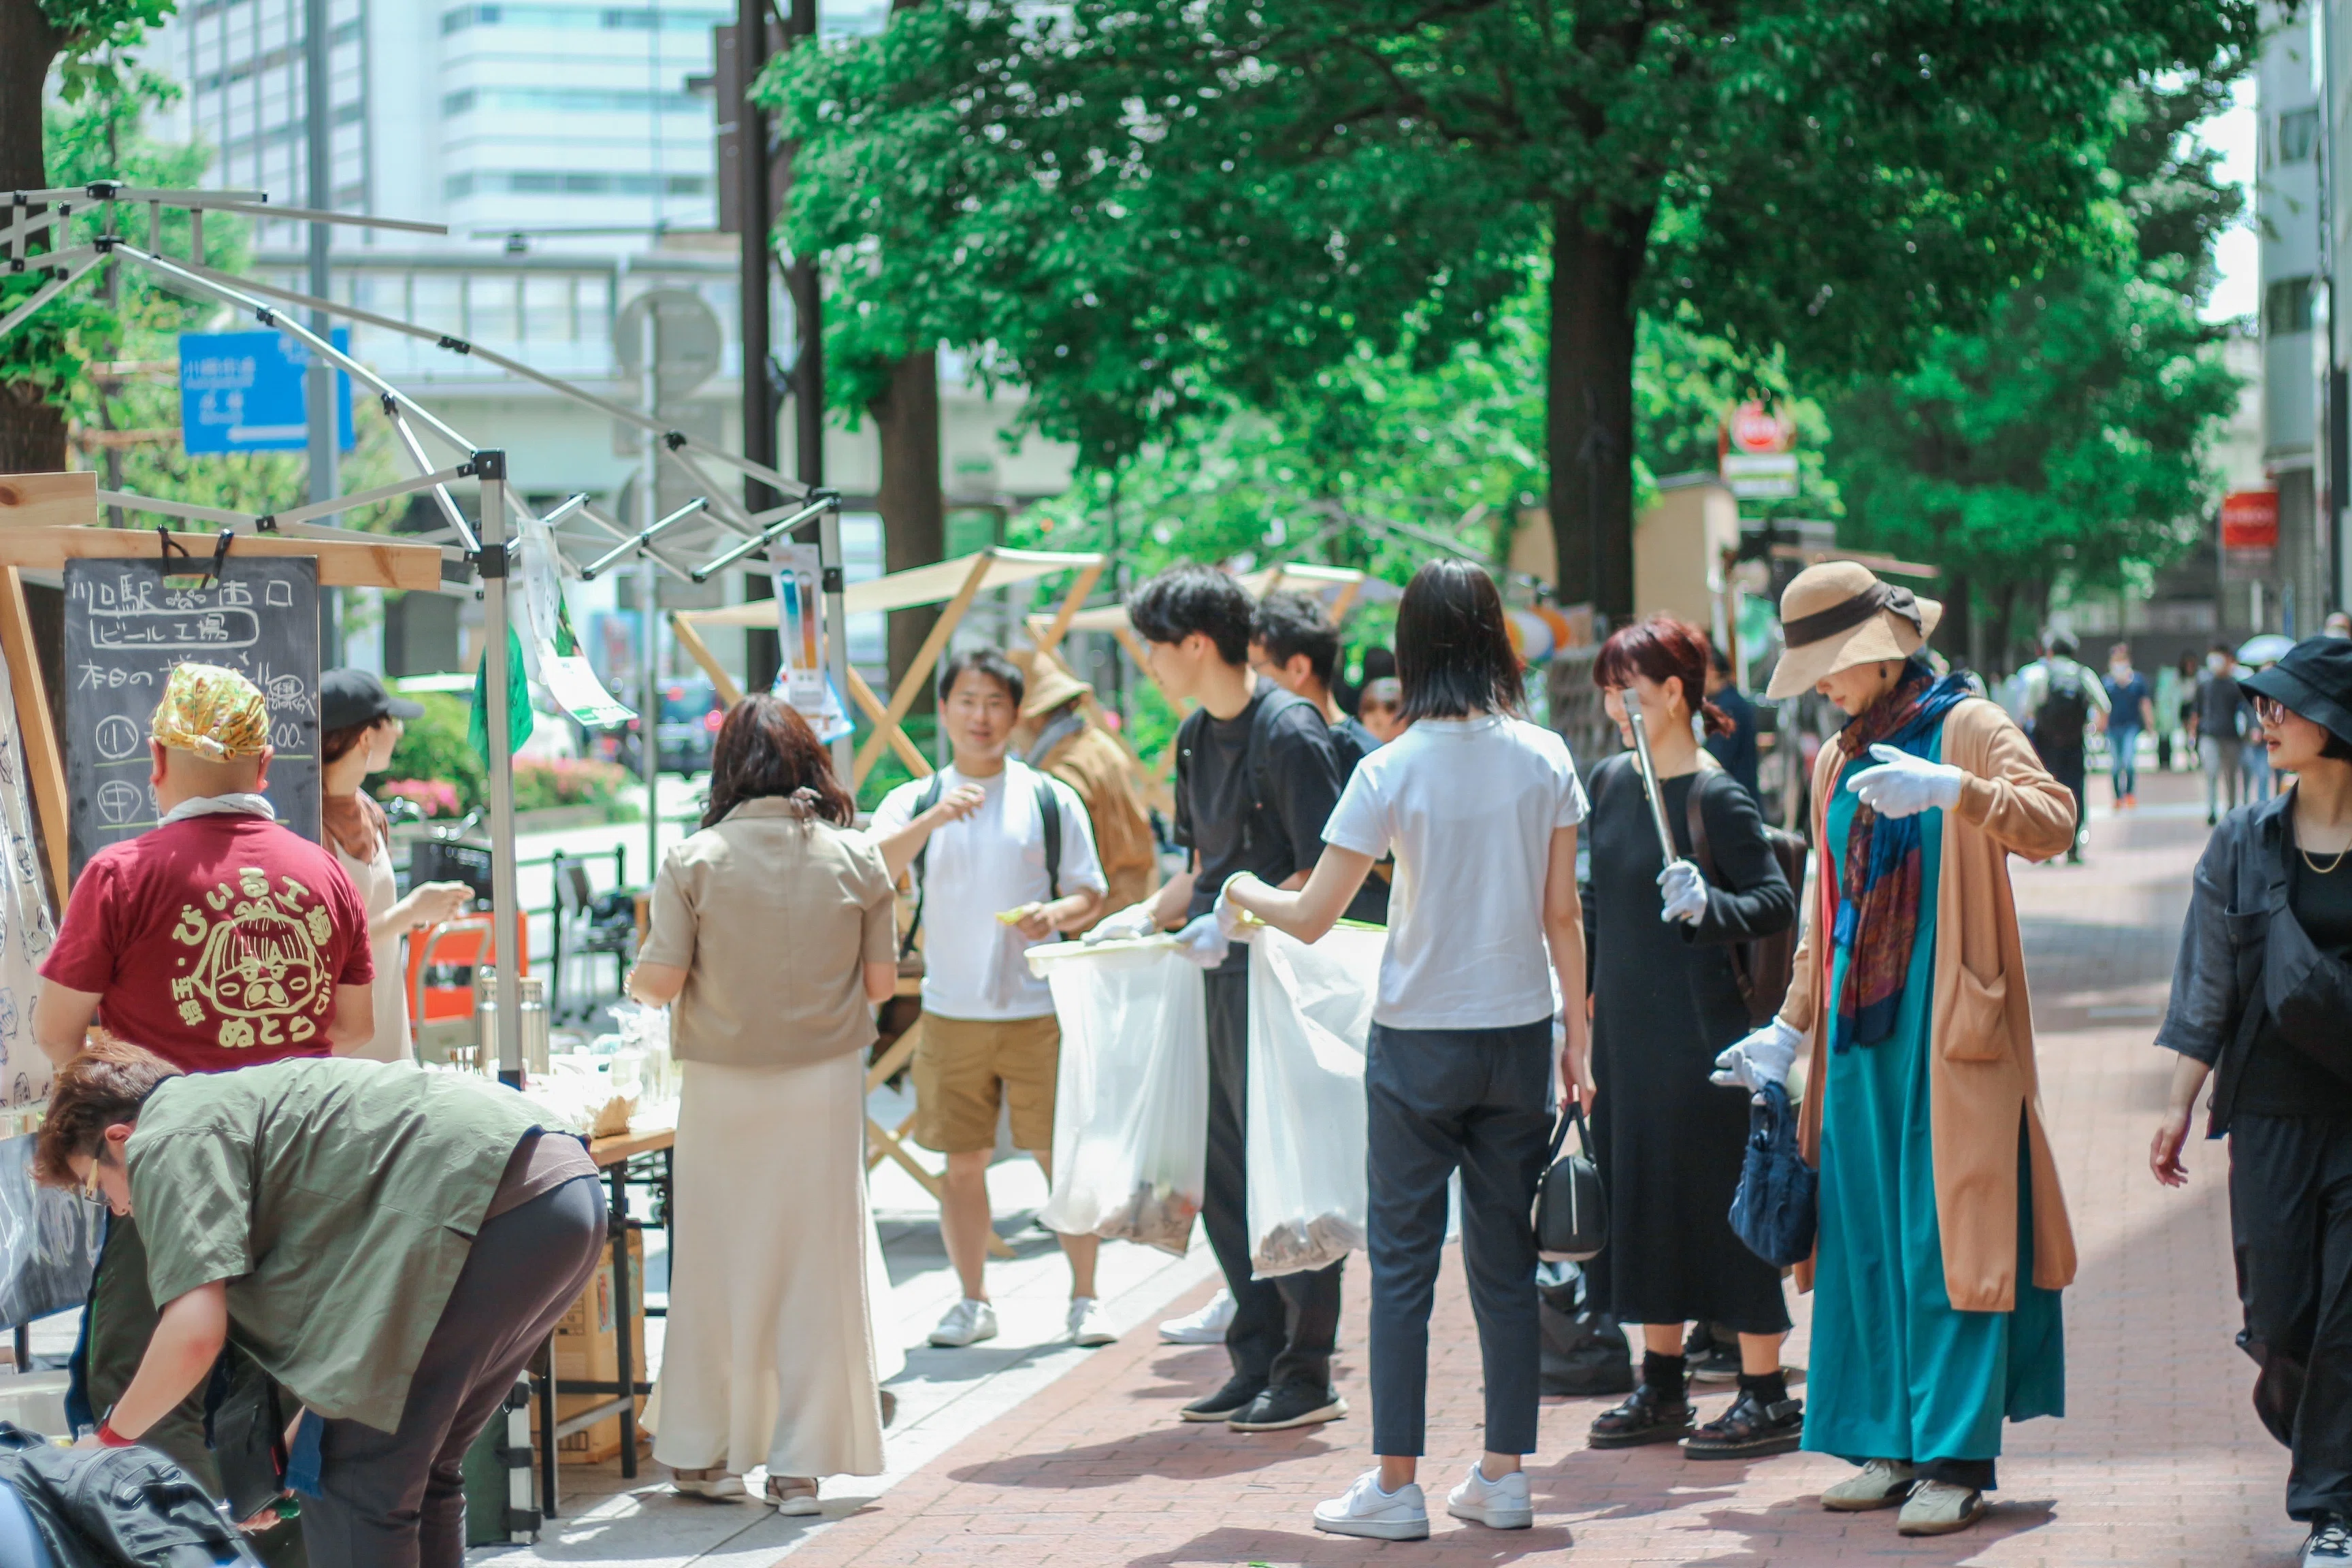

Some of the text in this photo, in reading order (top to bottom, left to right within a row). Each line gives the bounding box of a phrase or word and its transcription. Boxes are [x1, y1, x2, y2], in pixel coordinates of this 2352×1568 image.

[100, 612, 229, 645] ビール工場
